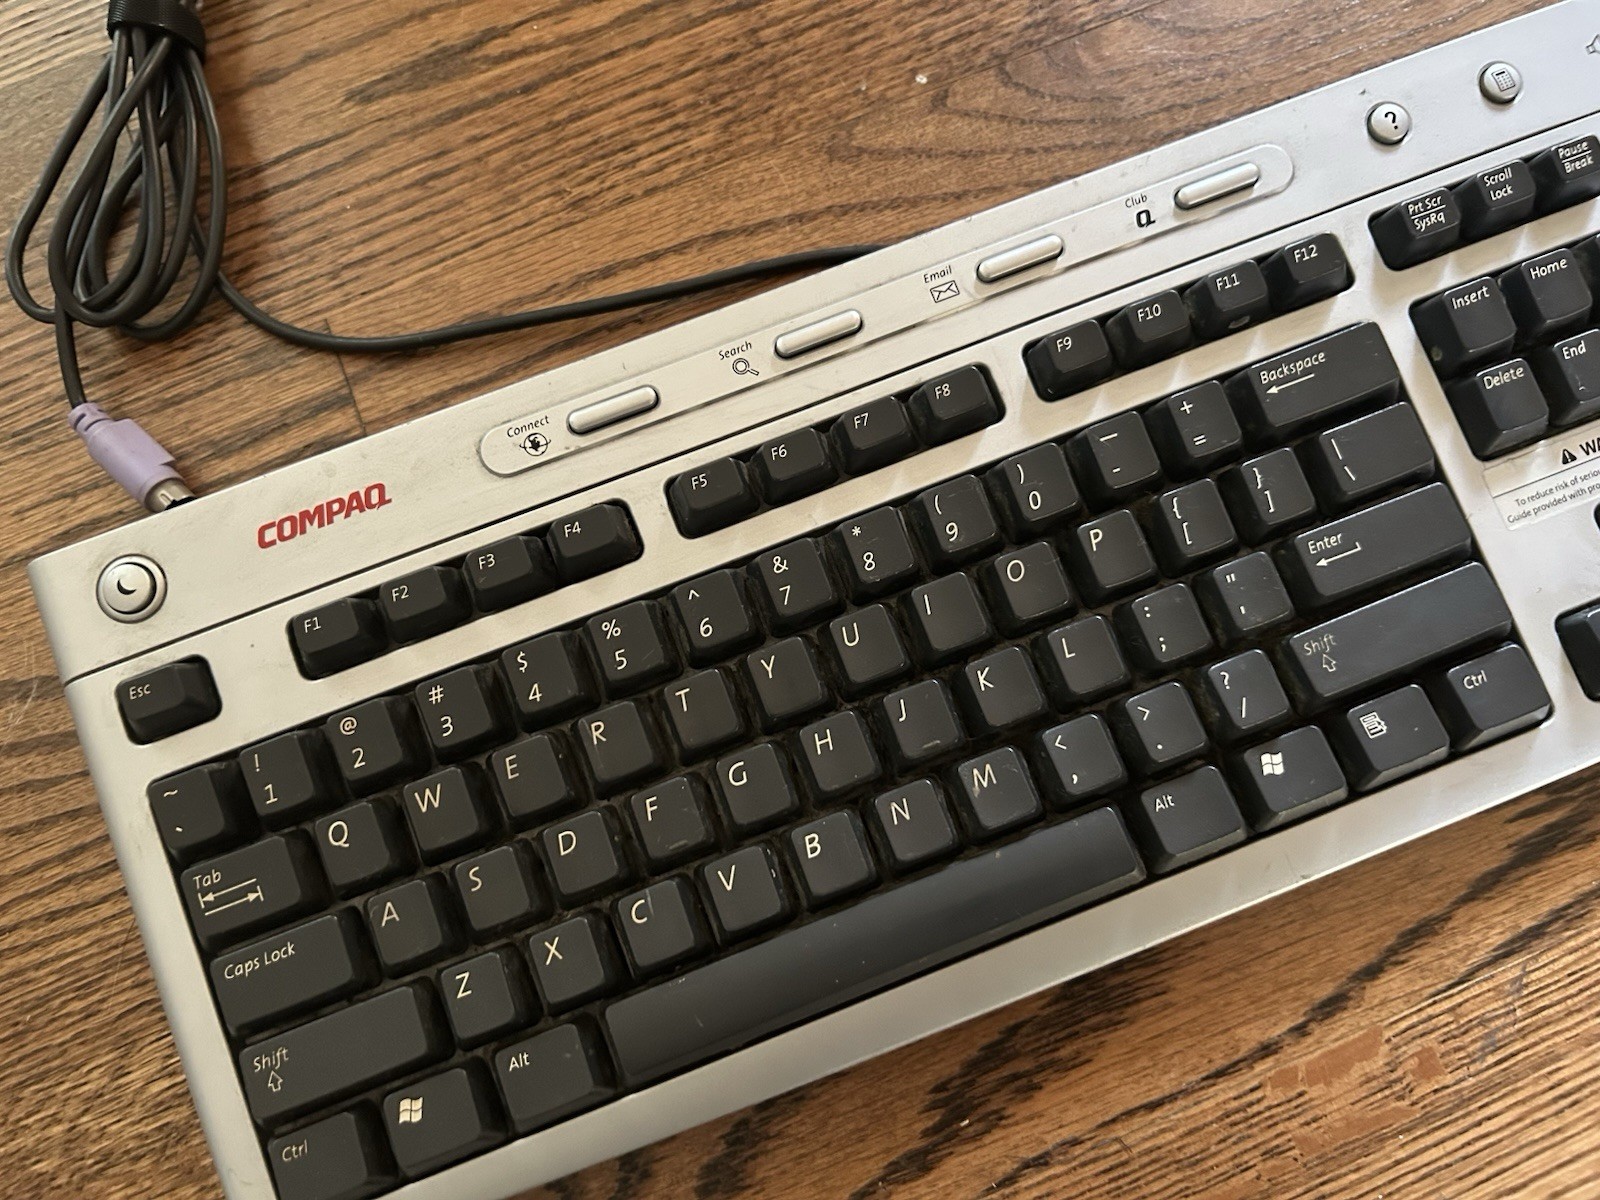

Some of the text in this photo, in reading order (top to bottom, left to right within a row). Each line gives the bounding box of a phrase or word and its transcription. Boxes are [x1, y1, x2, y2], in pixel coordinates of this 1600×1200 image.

[1384, 111, 1399, 130] ?
[1558, 140, 1589, 159] Pause
[1564, 154, 1594, 174] Break
[1483, 167, 1513, 187] Scroll
[1124, 192, 1148, 209] Club
[1489, 184, 1513, 201] Lock
[1407, 195, 1442, 215] Prt Scr
[1134, 208, 1156, 229] Q
[1413, 211, 1446, 232] SysRq
[1293, 244, 1318, 263] F12
[922, 265, 953, 284] Email
[1529, 258, 1568, 280] Home
[1215, 272, 1240, 292] F11
[1451, 285, 1490, 310] Insert
[1136, 303, 1162, 323] F1
[1136, 303, 1162, 323] F10
[718, 340, 753, 361] Search
[1056, 336, 1072, 353] F9
[1562, 340, 1586, 360] End
[1259, 351, 1326, 384] Backspace
[1482, 367, 1525, 390] Delete
[934, 383, 951, 400] F8
[1180, 400, 1194, 415] +
[506, 415, 550, 438] Connect
[853, 412, 869, 429] F7
[771, 444, 788, 461] F6
[1579, 437, 1600, 456] W
[691, 473, 708, 490] F5
[1016, 463, 1025, 485] )
[1252, 467, 1262, 490] }
[1028, 490, 1042, 510] 0
[1264, 490, 1275, 513] ]
[1515, 498, 1526, 507] To
[1527, 487, 1554, 502] reduce
[1554, 480, 1570, 492] risk
[1569, 475, 1579, 486] of
[257, 482, 392, 549] COMPAQ
[934, 494, 942, 515] (
[1172, 496, 1182, 520] {
[1506, 509, 1532, 524] Guide
[1532, 493, 1568, 516] provided
[1567, 487, 1587, 500] with
[564, 521, 582, 538] F4
[945, 522, 958, 542] 9
[1089, 528, 1103, 552] P
[1182, 521, 1193, 545] [
[1308, 532, 1342, 555] Enter
[478, 553, 496, 570] F3
[772, 555, 789, 574] &
[863, 551, 876, 572] 8
[1006, 559, 1025, 582] O
[391, 585, 410, 602] F2
[778, 584, 791, 606] 7
[923, 594, 932, 616] I
[601, 618, 622, 640] %
[699, 617, 713, 638] 6
[841, 622, 860, 647] U
[1061, 637, 1076, 659] L
[1303, 632, 1338, 655] Shift
[516, 651, 528, 673] $
[614, 648, 628, 670] 5
[760, 654, 775, 679] Y
[976, 666, 994, 692] K
[1219, 671, 1231, 690] ?
[1463, 669, 1487, 690] Ctrl
[129, 683, 151, 700] Esc
[428, 684, 444, 705] #
[528, 683, 543, 702] 4
[674, 688, 690, 712] T
[898, 698, 907, 722] J
[1137, 706, 1150, 721] >
[1241, 697, 1247, 719] /
[339, 716, 358, 736] @
[440, 715, 454, 737] 3
[590, 721, 607, 746] R
[814, 728, 834, 756] H
[1054, 734, 1067, 750] <
[352, 747, 366, 769] 2
[505, 754, 520, 780] E
[728, 761, 748, 787] G
[972, 763, 997, 789] M
[264, 783, 278, 805] 1
[414, 783, 441, 813] W
[1155, 794, 1175, 813] Alt
[645, 796, 658, 822] F
[890, 797, 911, 826] N
[328, 820, 350, 848] Q
[558, 830, 577, 856] D
[804, 833, 822, 859] B
[193, 869, 222, 891] Tab
[468, 866, 482, 892] S
[717, 864, 736, 891] V
[381, 901, 400, 927] A
[631, 899, 648, 924] C
[224, 941, 296, 980] Caps Lock
[544, 936, 563, 966] X
[455, 971, 472, 999] Z
[253, 1046, 289, 1073] Shift
[509, 1052, 530, 1072] Alt
[282, 1139, 308, 1162] Ctrl
